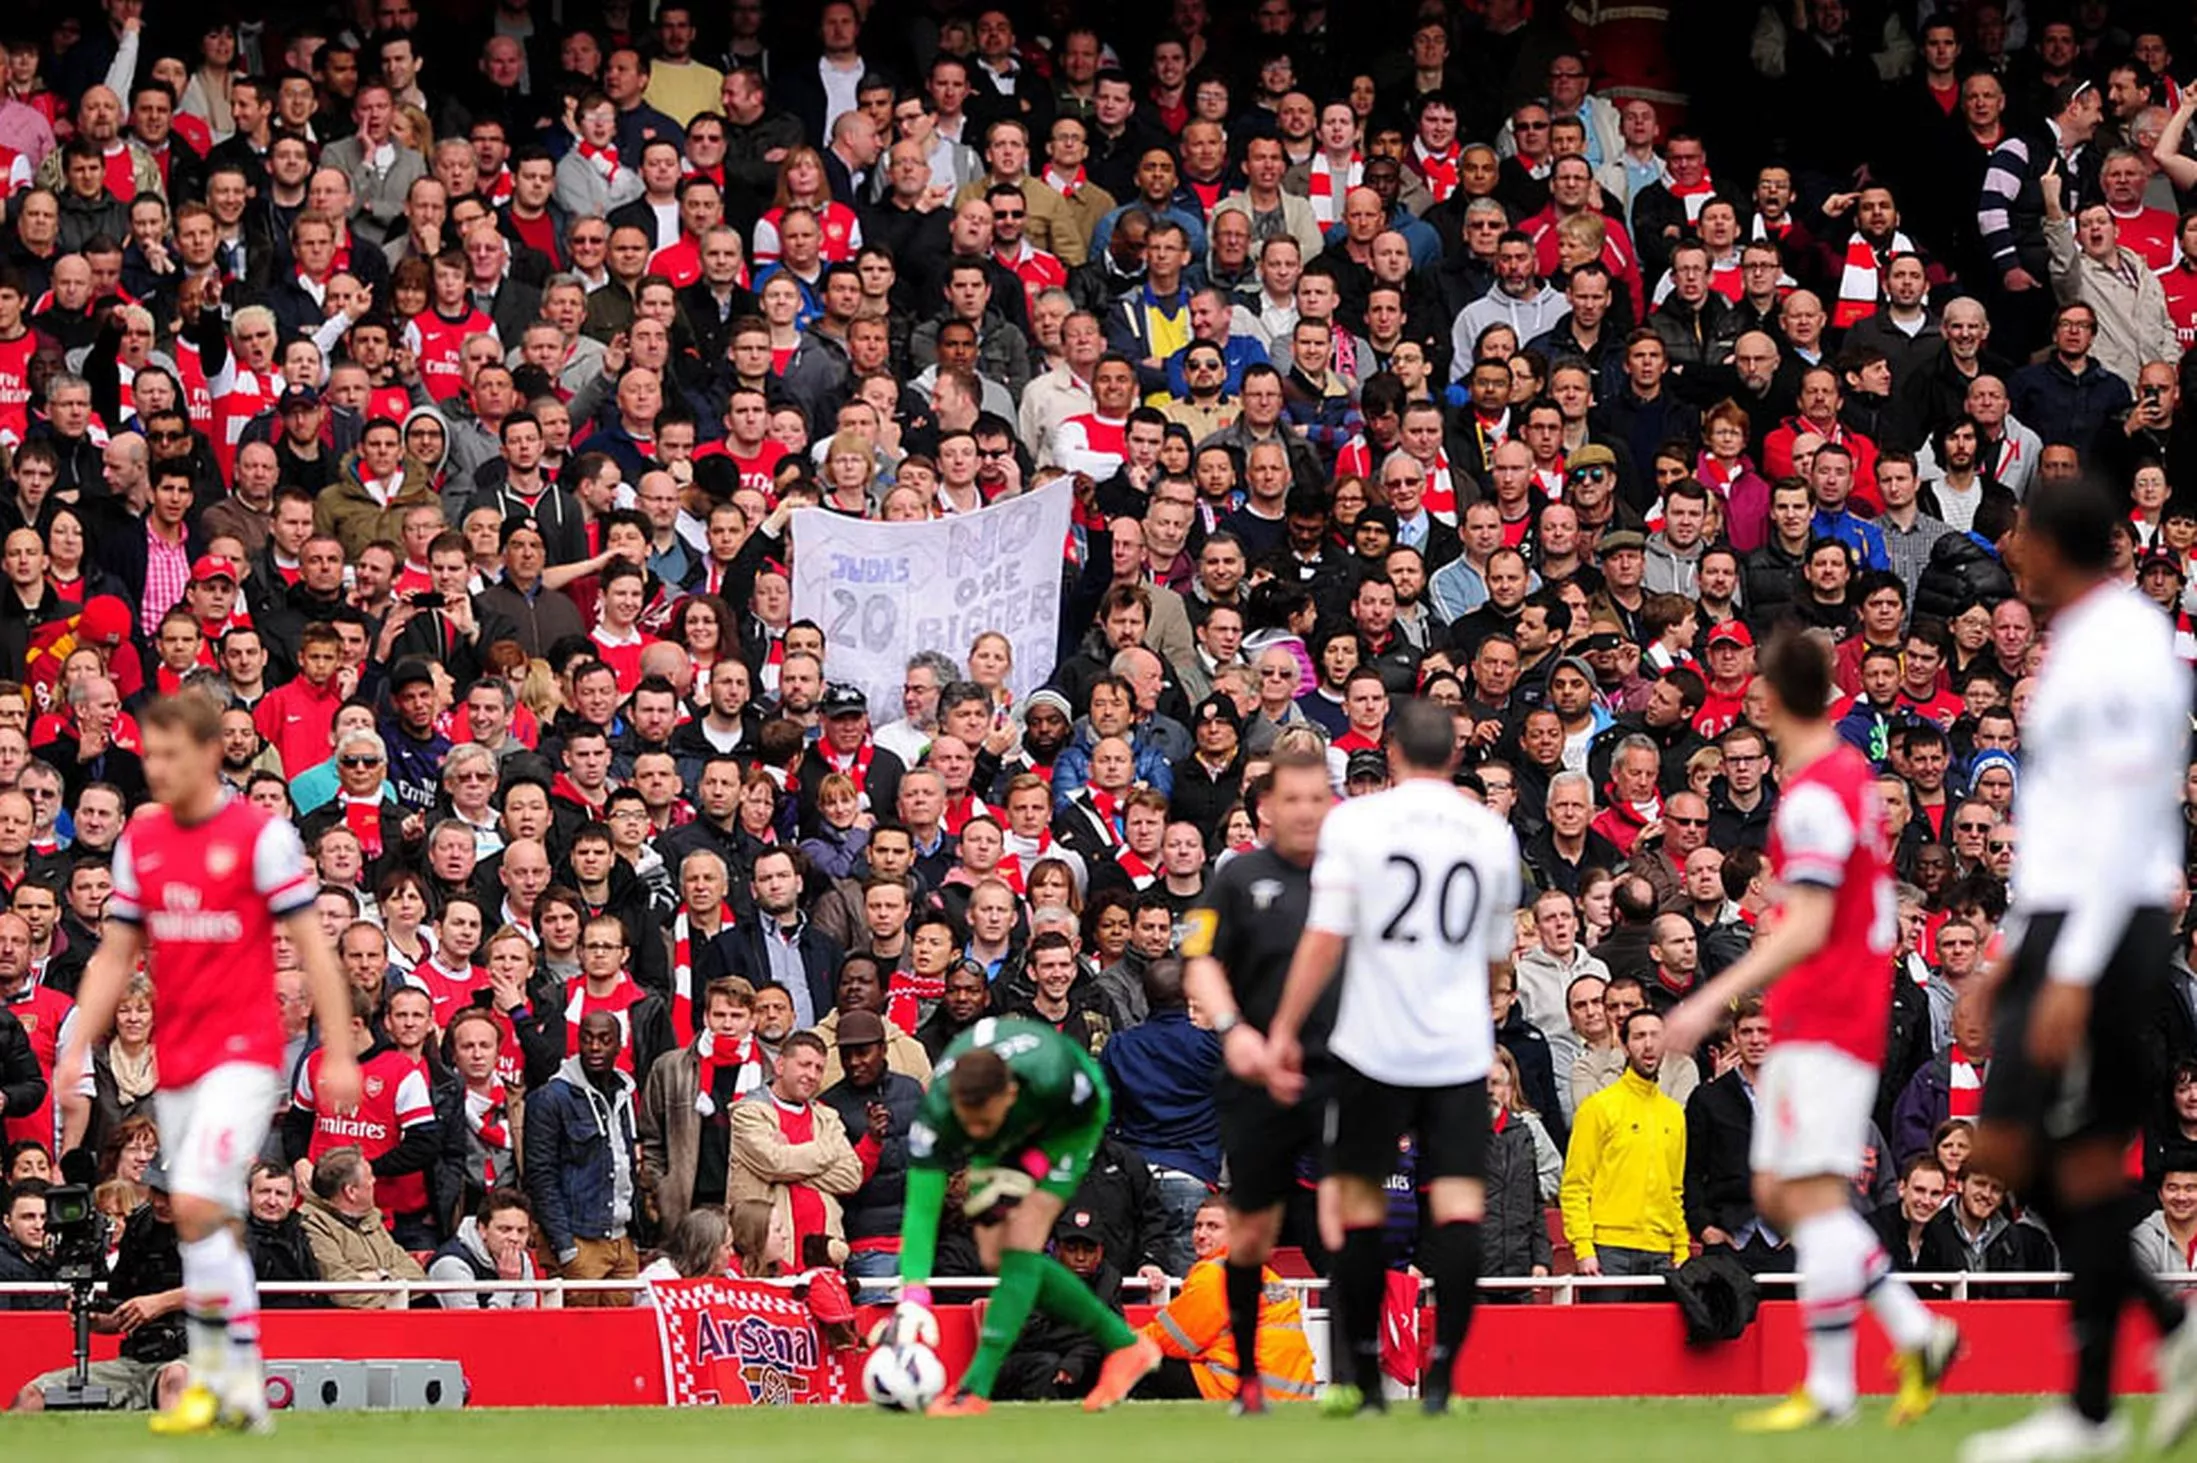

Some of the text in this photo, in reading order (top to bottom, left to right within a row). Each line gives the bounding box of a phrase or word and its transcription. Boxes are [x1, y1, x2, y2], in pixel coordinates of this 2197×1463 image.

[946, 500, 1042, 578] NO
[955, 560, 1022, 607] ONE
[827, 588, 898, 654] 20
[1382, 854, 1480, 945] 20
[317, 1113, 387, 1139] mirates
[697, 1310, 819, 1370] Arsenal
